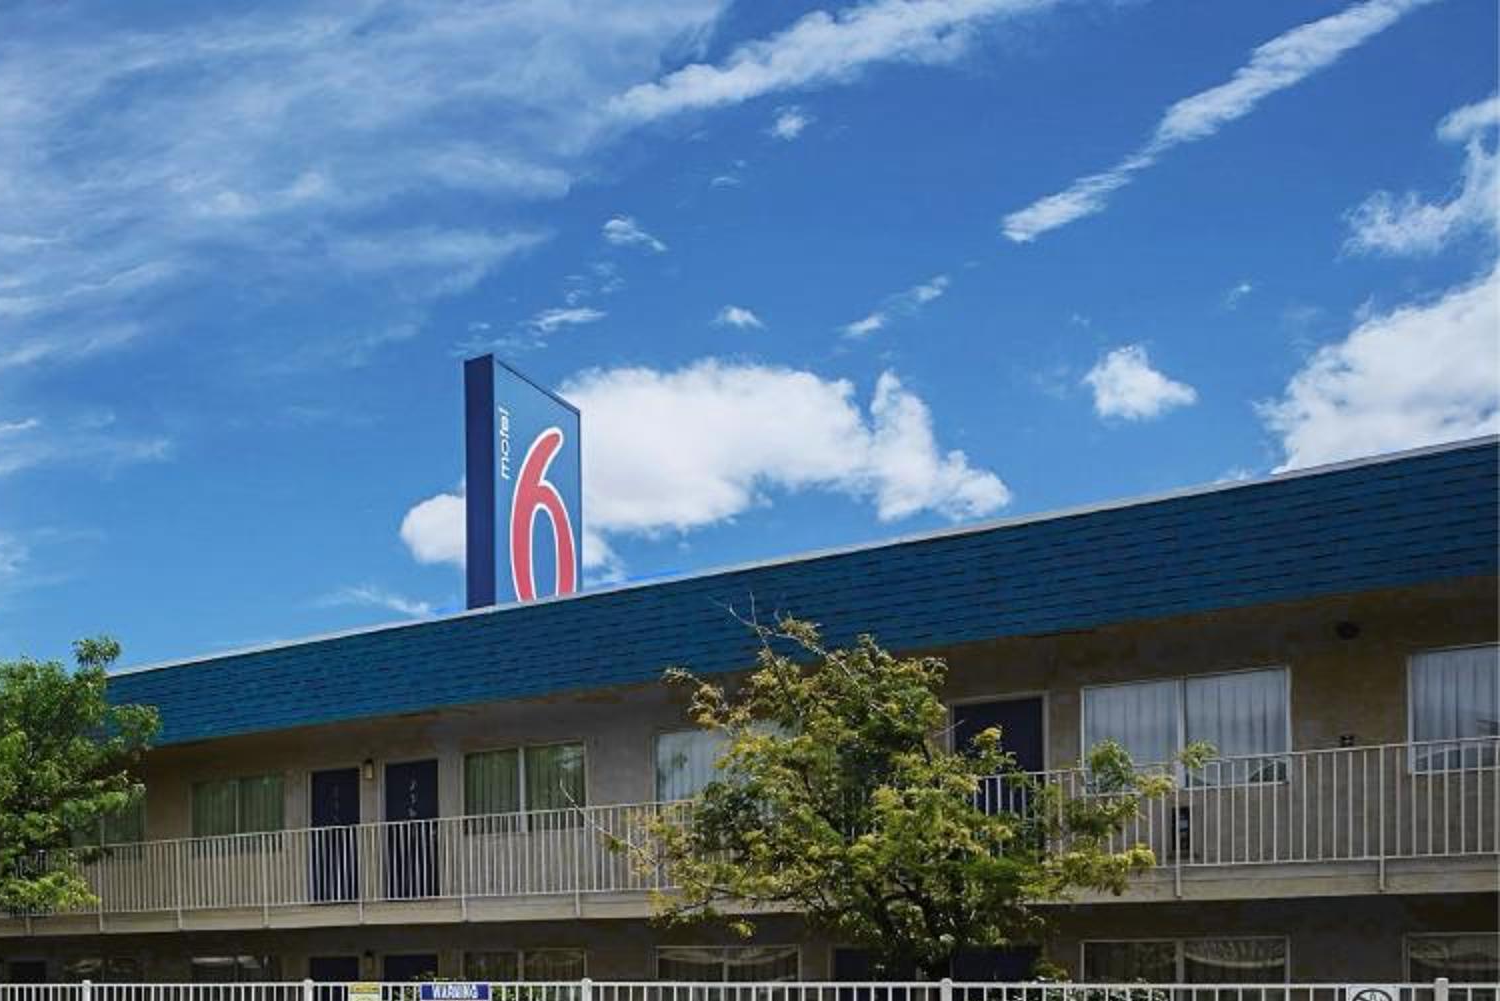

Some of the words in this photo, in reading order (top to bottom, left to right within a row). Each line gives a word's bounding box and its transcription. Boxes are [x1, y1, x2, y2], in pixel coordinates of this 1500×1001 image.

[498, 405, 511, 480] motel
[510, 427, 577, 603] 6
[432, 984, 478, 998] WARNING
